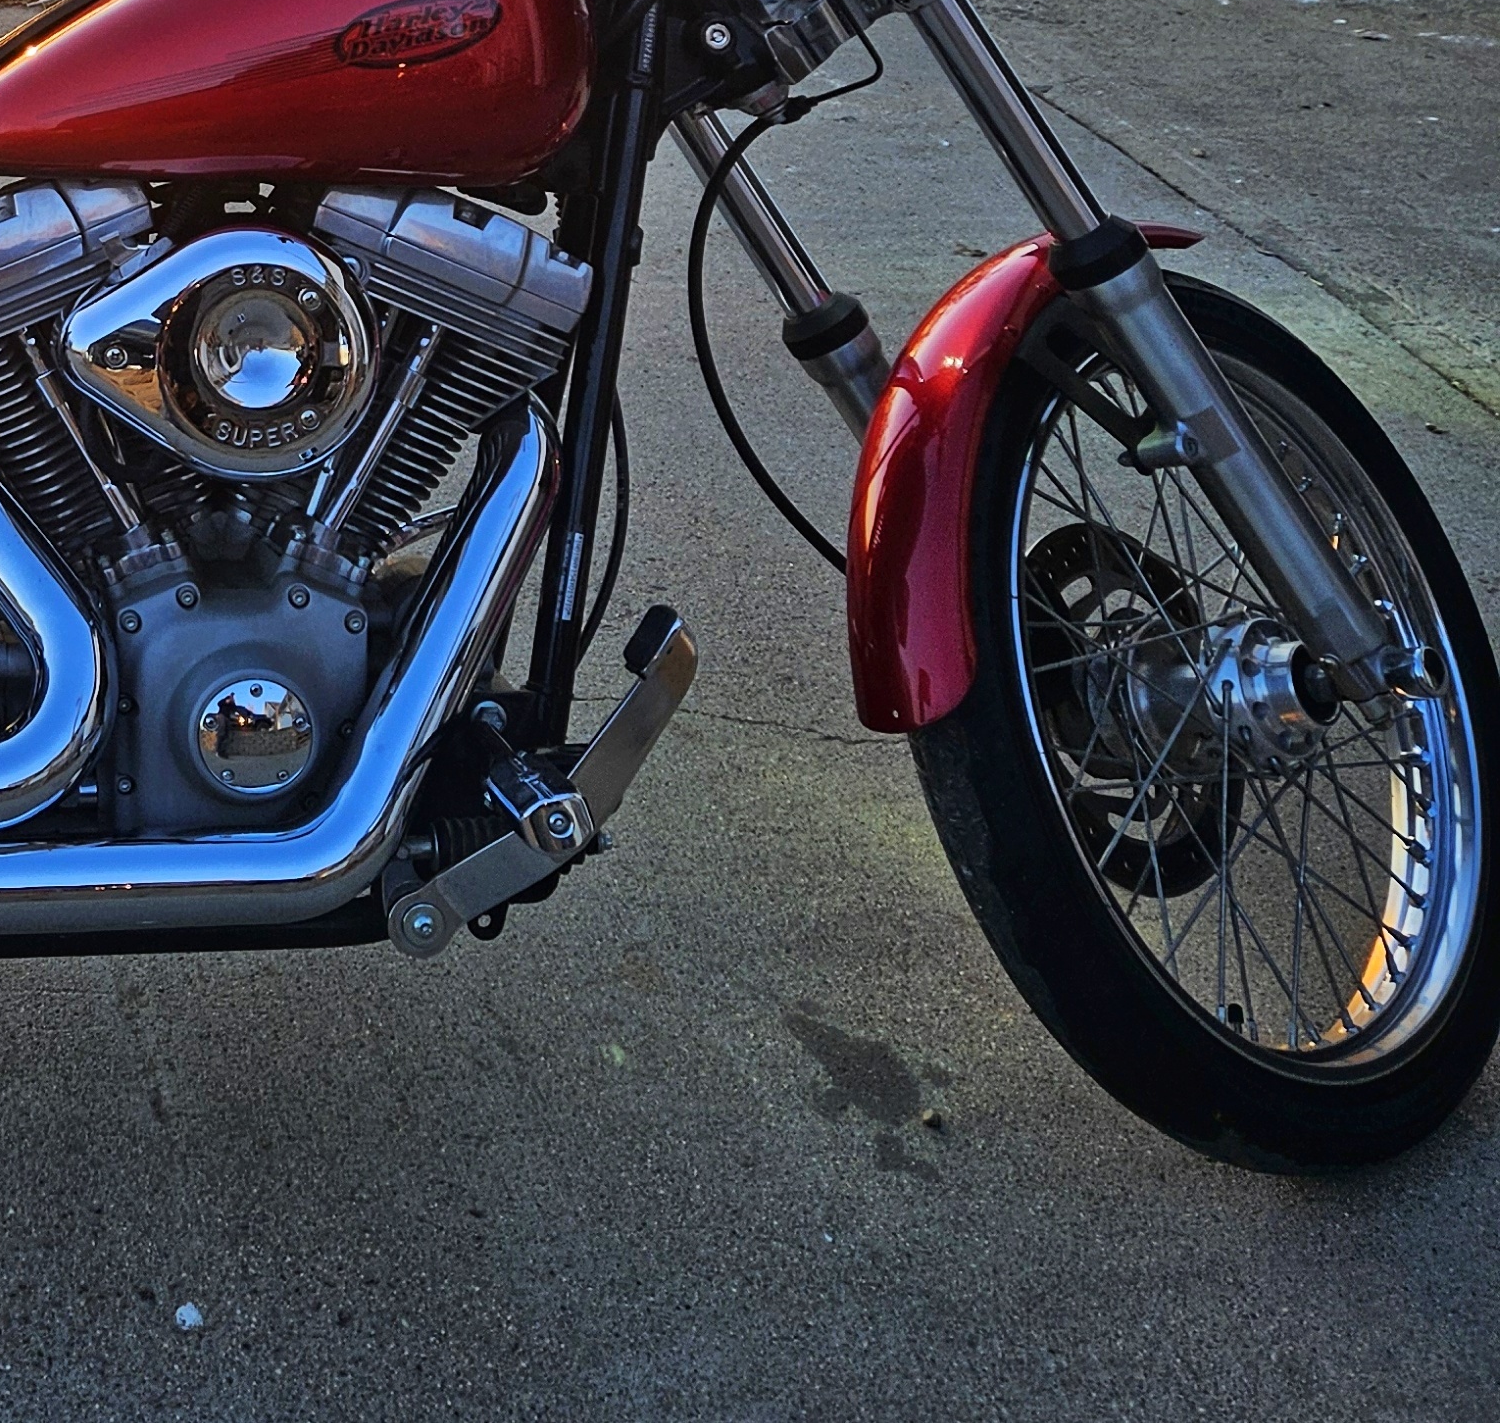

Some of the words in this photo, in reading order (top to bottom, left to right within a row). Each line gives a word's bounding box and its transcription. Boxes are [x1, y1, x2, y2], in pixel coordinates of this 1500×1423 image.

[347, 16, 492, 60] Davidson
[231, 264, 286, 286] S&S
[215, 421, 299, 449] SUPER
